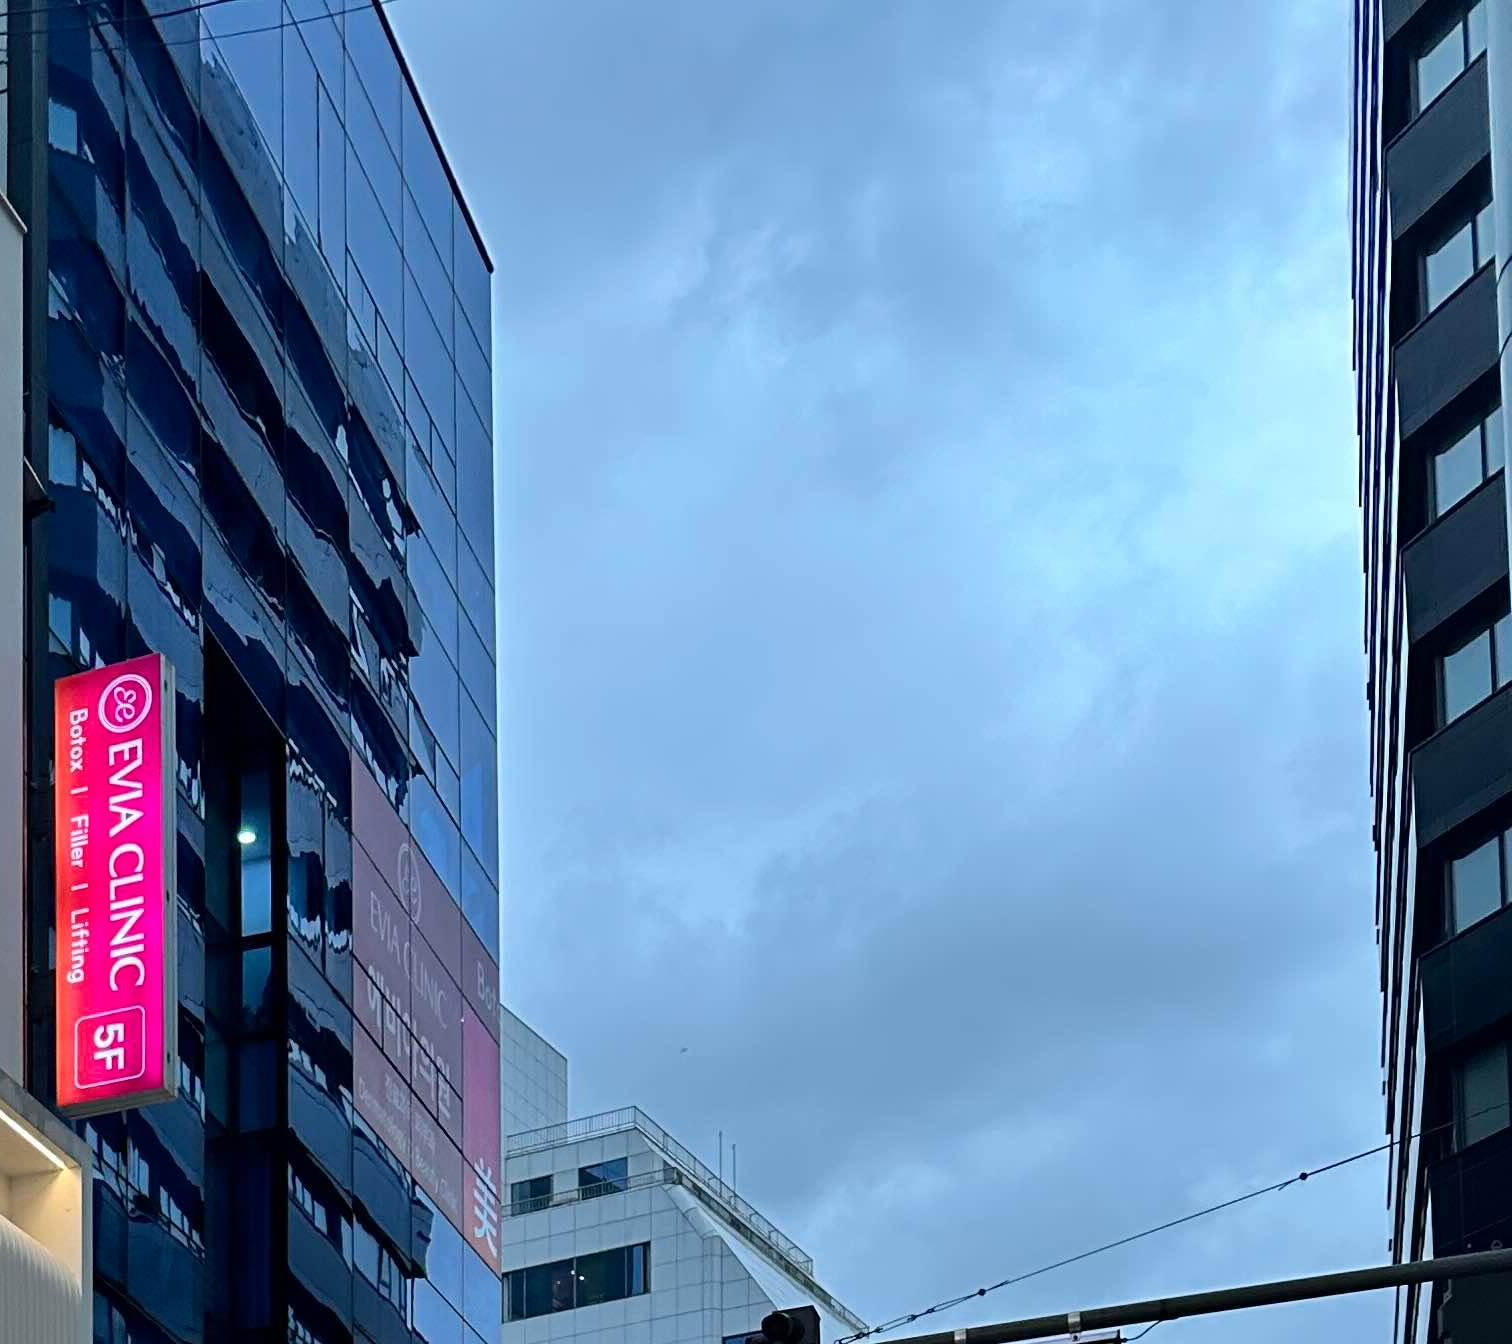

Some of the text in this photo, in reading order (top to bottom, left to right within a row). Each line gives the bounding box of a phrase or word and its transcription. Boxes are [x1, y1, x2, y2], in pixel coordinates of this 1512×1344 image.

[66, 707, 89, 985] Botox Filler Lifting
[107, 738, 146, 992] EVIA CLINIC
[93, 1021, 125, 1072] 5F
